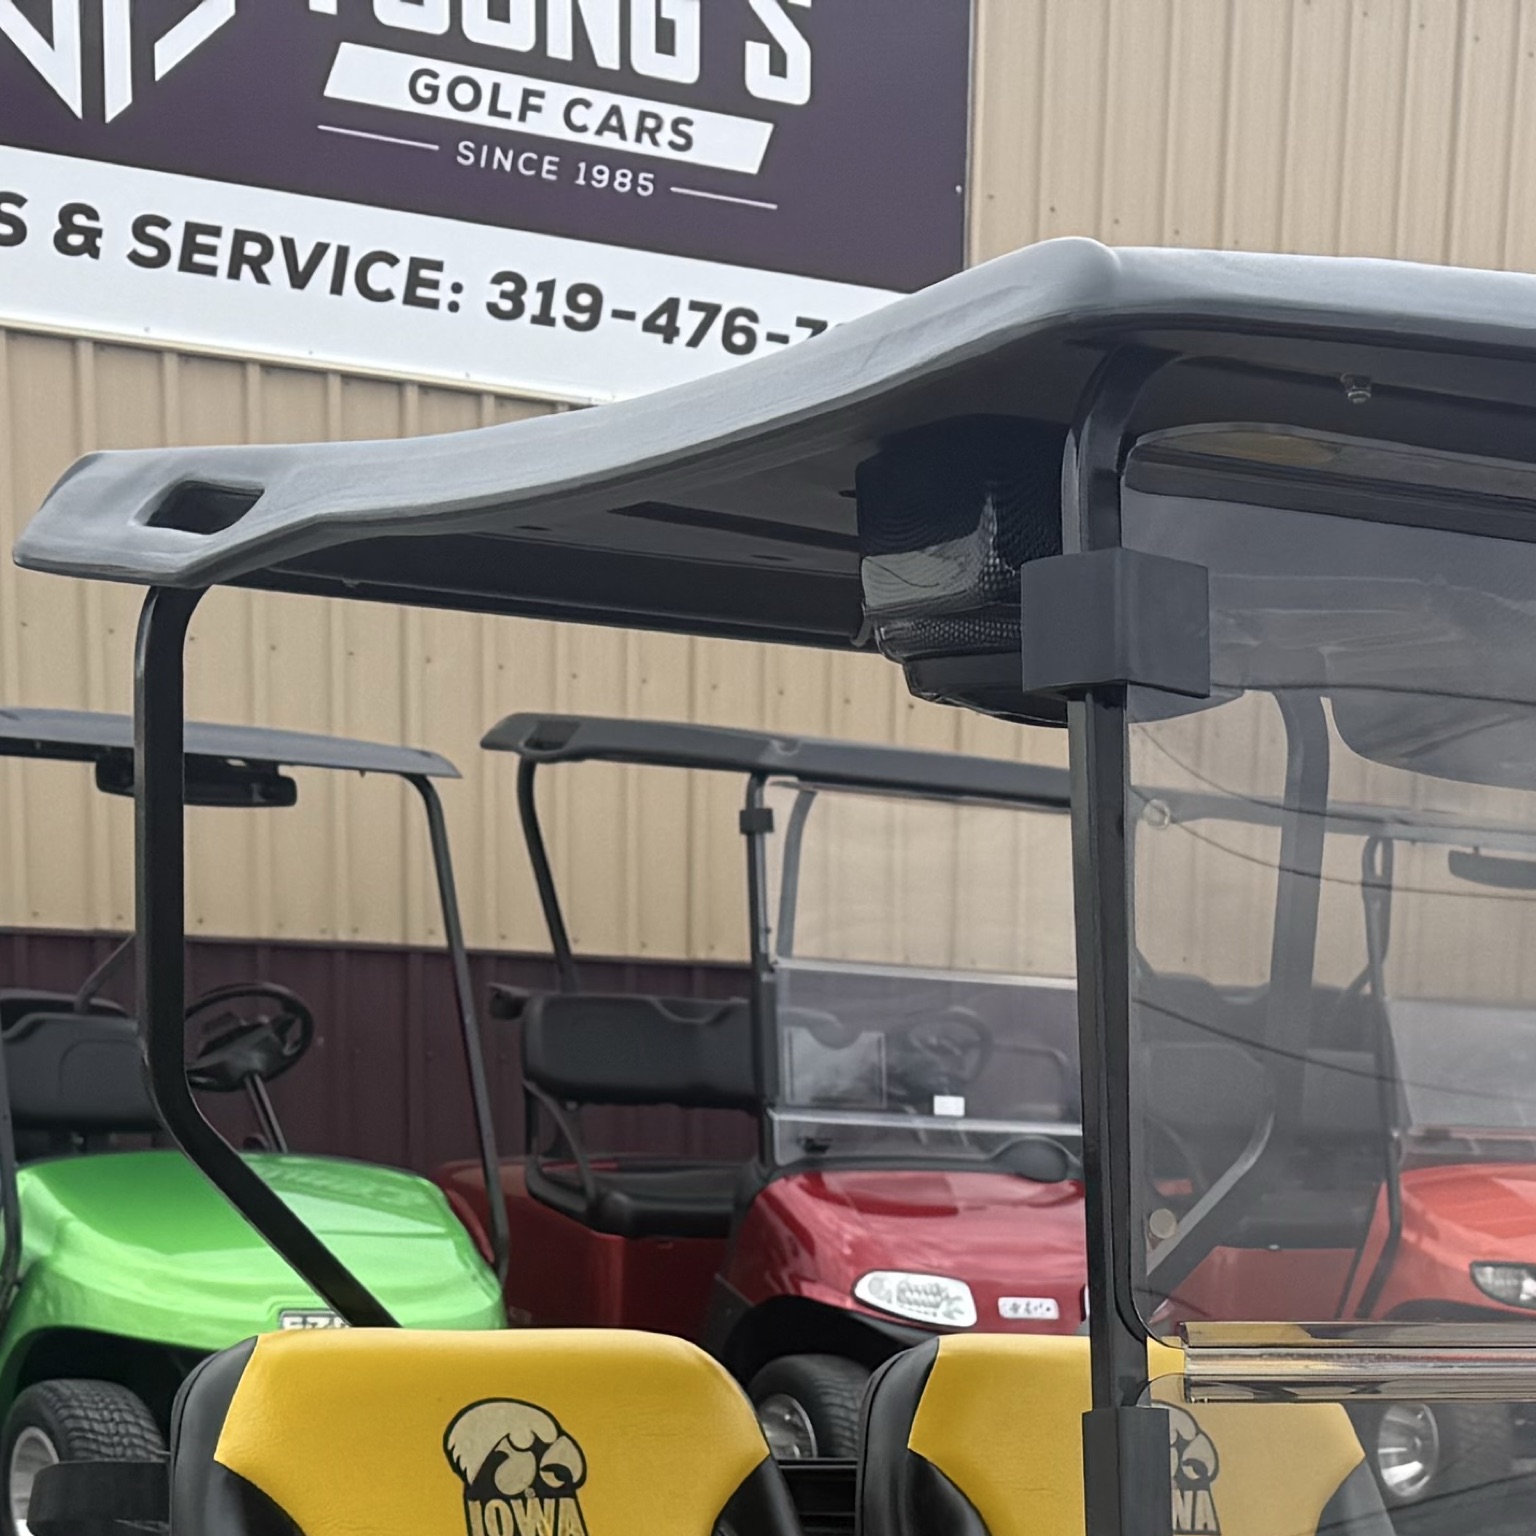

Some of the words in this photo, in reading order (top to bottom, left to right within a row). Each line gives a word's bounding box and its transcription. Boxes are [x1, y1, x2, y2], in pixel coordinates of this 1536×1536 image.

[408, 68, 546, 123] GOLF
[564, 97, 694, 152] CARS
[457, 141, 560, 181] SINCE
[576, 161, 655, 197] 1985
[53, 203, 103, 259] &
[126, 214, 464, 313] SERVICE:
